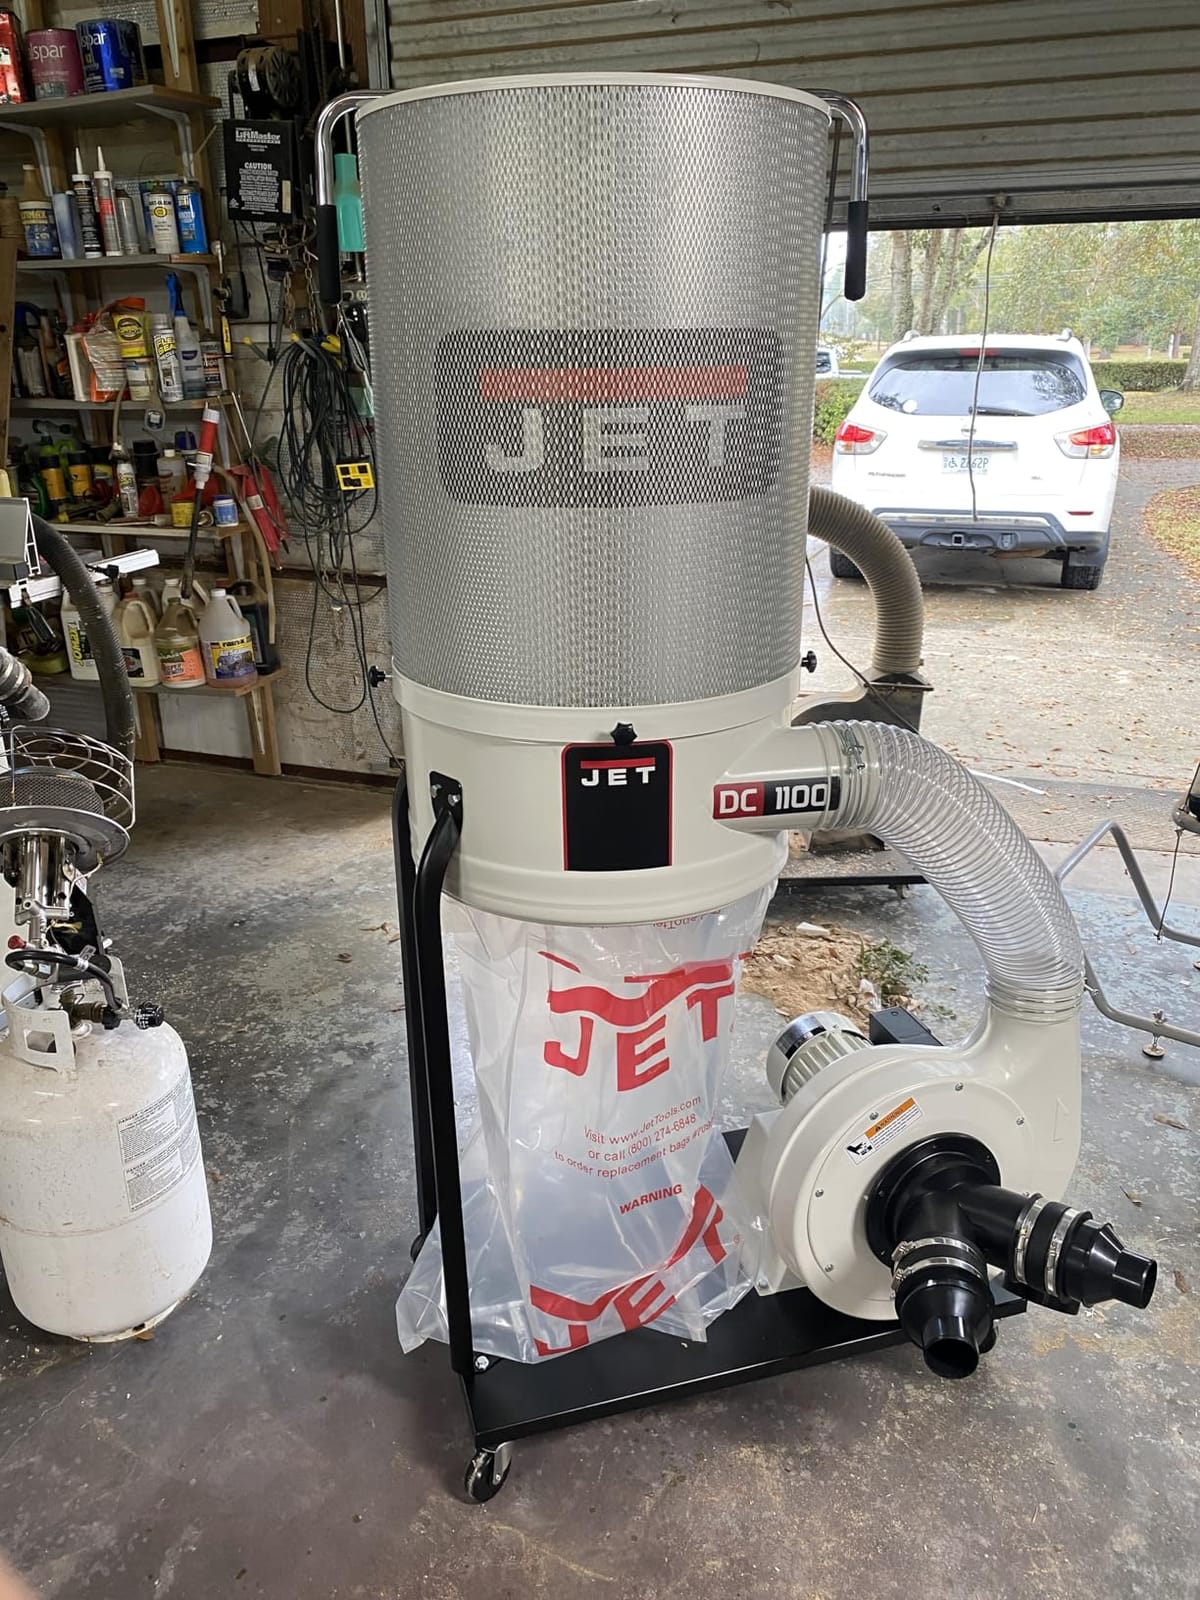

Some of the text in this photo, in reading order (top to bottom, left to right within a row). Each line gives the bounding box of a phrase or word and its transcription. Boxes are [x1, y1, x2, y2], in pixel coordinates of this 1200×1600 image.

[235, 130, 281, 140] LiftMaster
[244, 162, 273, 170] CAUTION
[484, 404, 748, 473] JET
[581, 765, 656, 787] JET
[719, 784, 828, 814] DC 1100
[544, 980, 735, 1092] JET
[584, 1096, 702, 1145] Visit www.JetTools.com
[588, 1113, 697, 1162] or call (800) 274-6848
[555, 1151, 565, 1162] to
[567, 1157, 593, 1176] order
[597, 1148, 667, 1180] replacement
[669, 1136, 691, 1153] bags
[619, 1184, 683, 1215] WARNING
